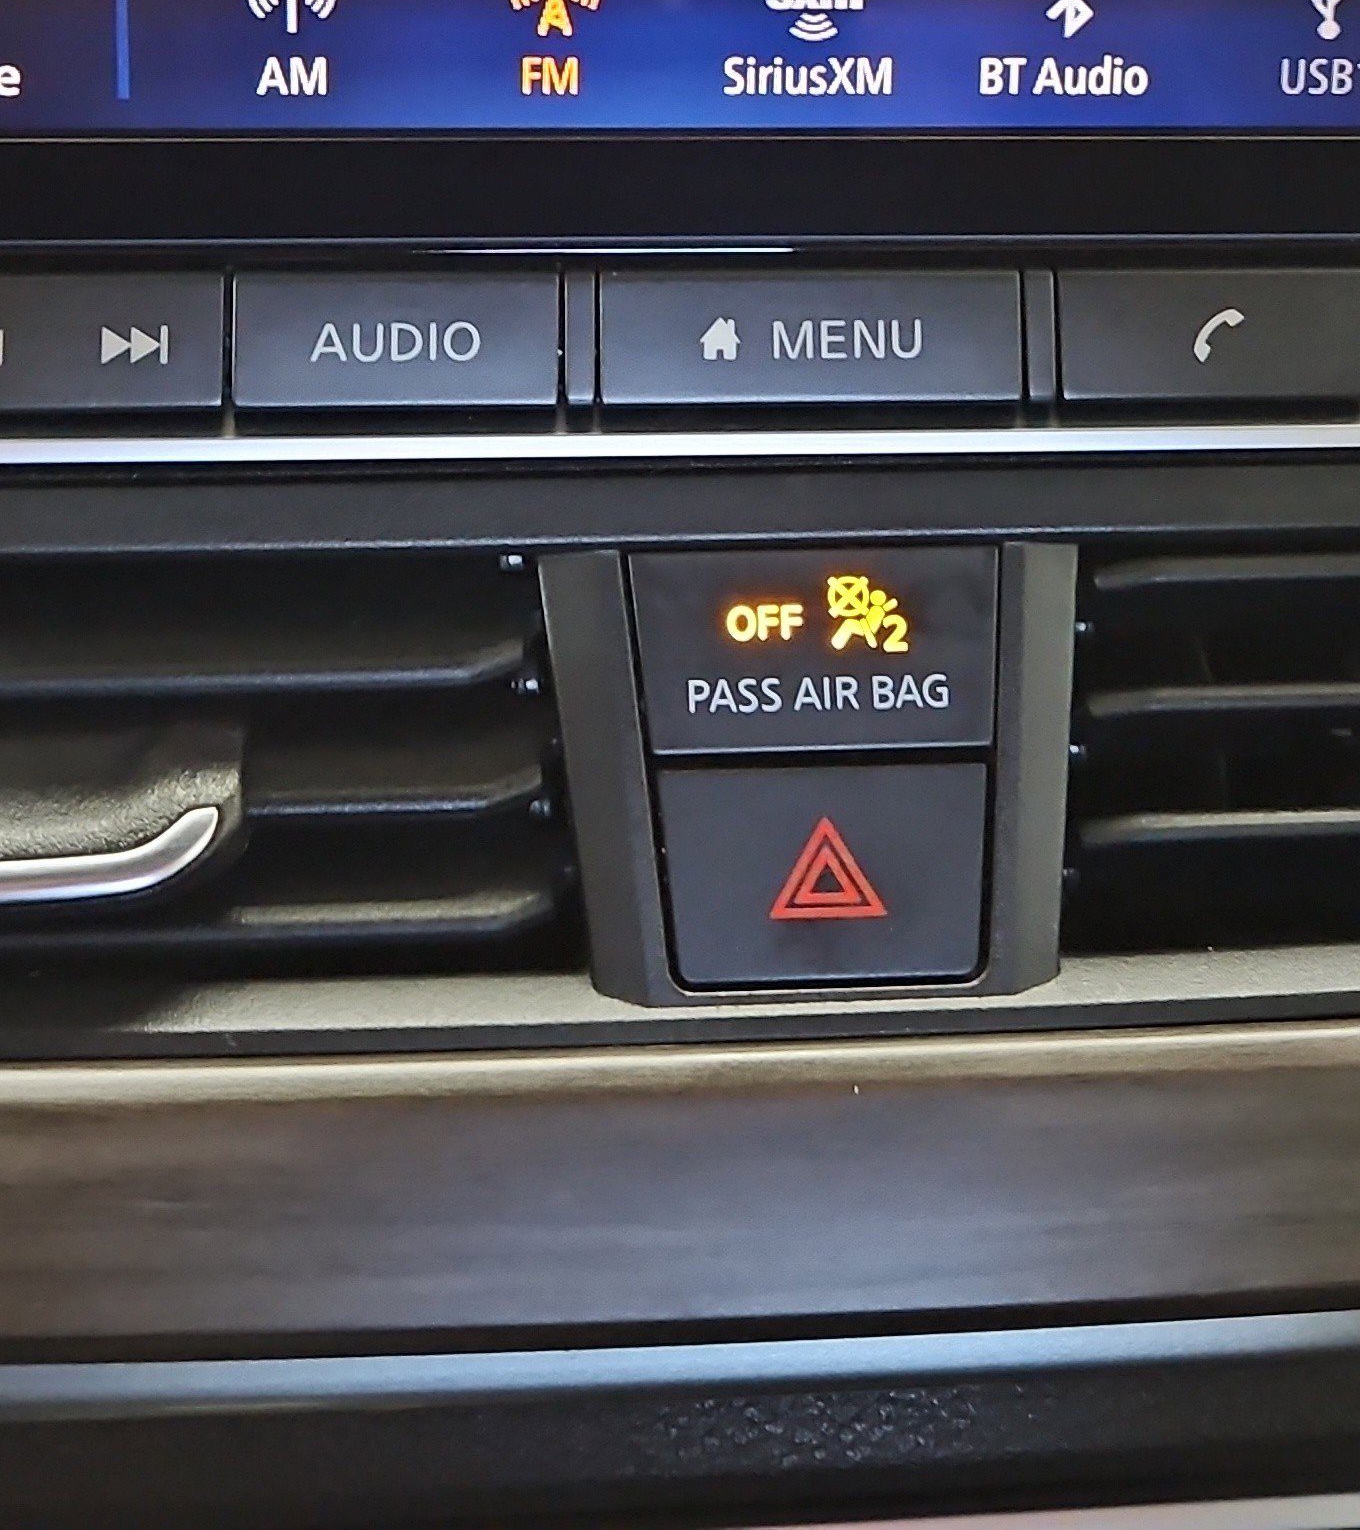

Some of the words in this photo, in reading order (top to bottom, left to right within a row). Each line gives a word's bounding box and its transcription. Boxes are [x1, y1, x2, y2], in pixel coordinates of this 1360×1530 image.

[255, 56, 327, 96] AM
[522, 56, 579, 96] FM
[723, 56, 893, 96] SiriusXM
[979, 57, 1028, 95] BT
[1032, 54, 1149, 96] Audio
[310, 321, 481, 363] AUDIO
[772, 318, 922, 360] MENU
[725, 602, 804, 642] OFF
[687, 677, 782, 714] PASS
[793, 676, 860, 711] AIR
[871, 673, 949, 710] BAG
